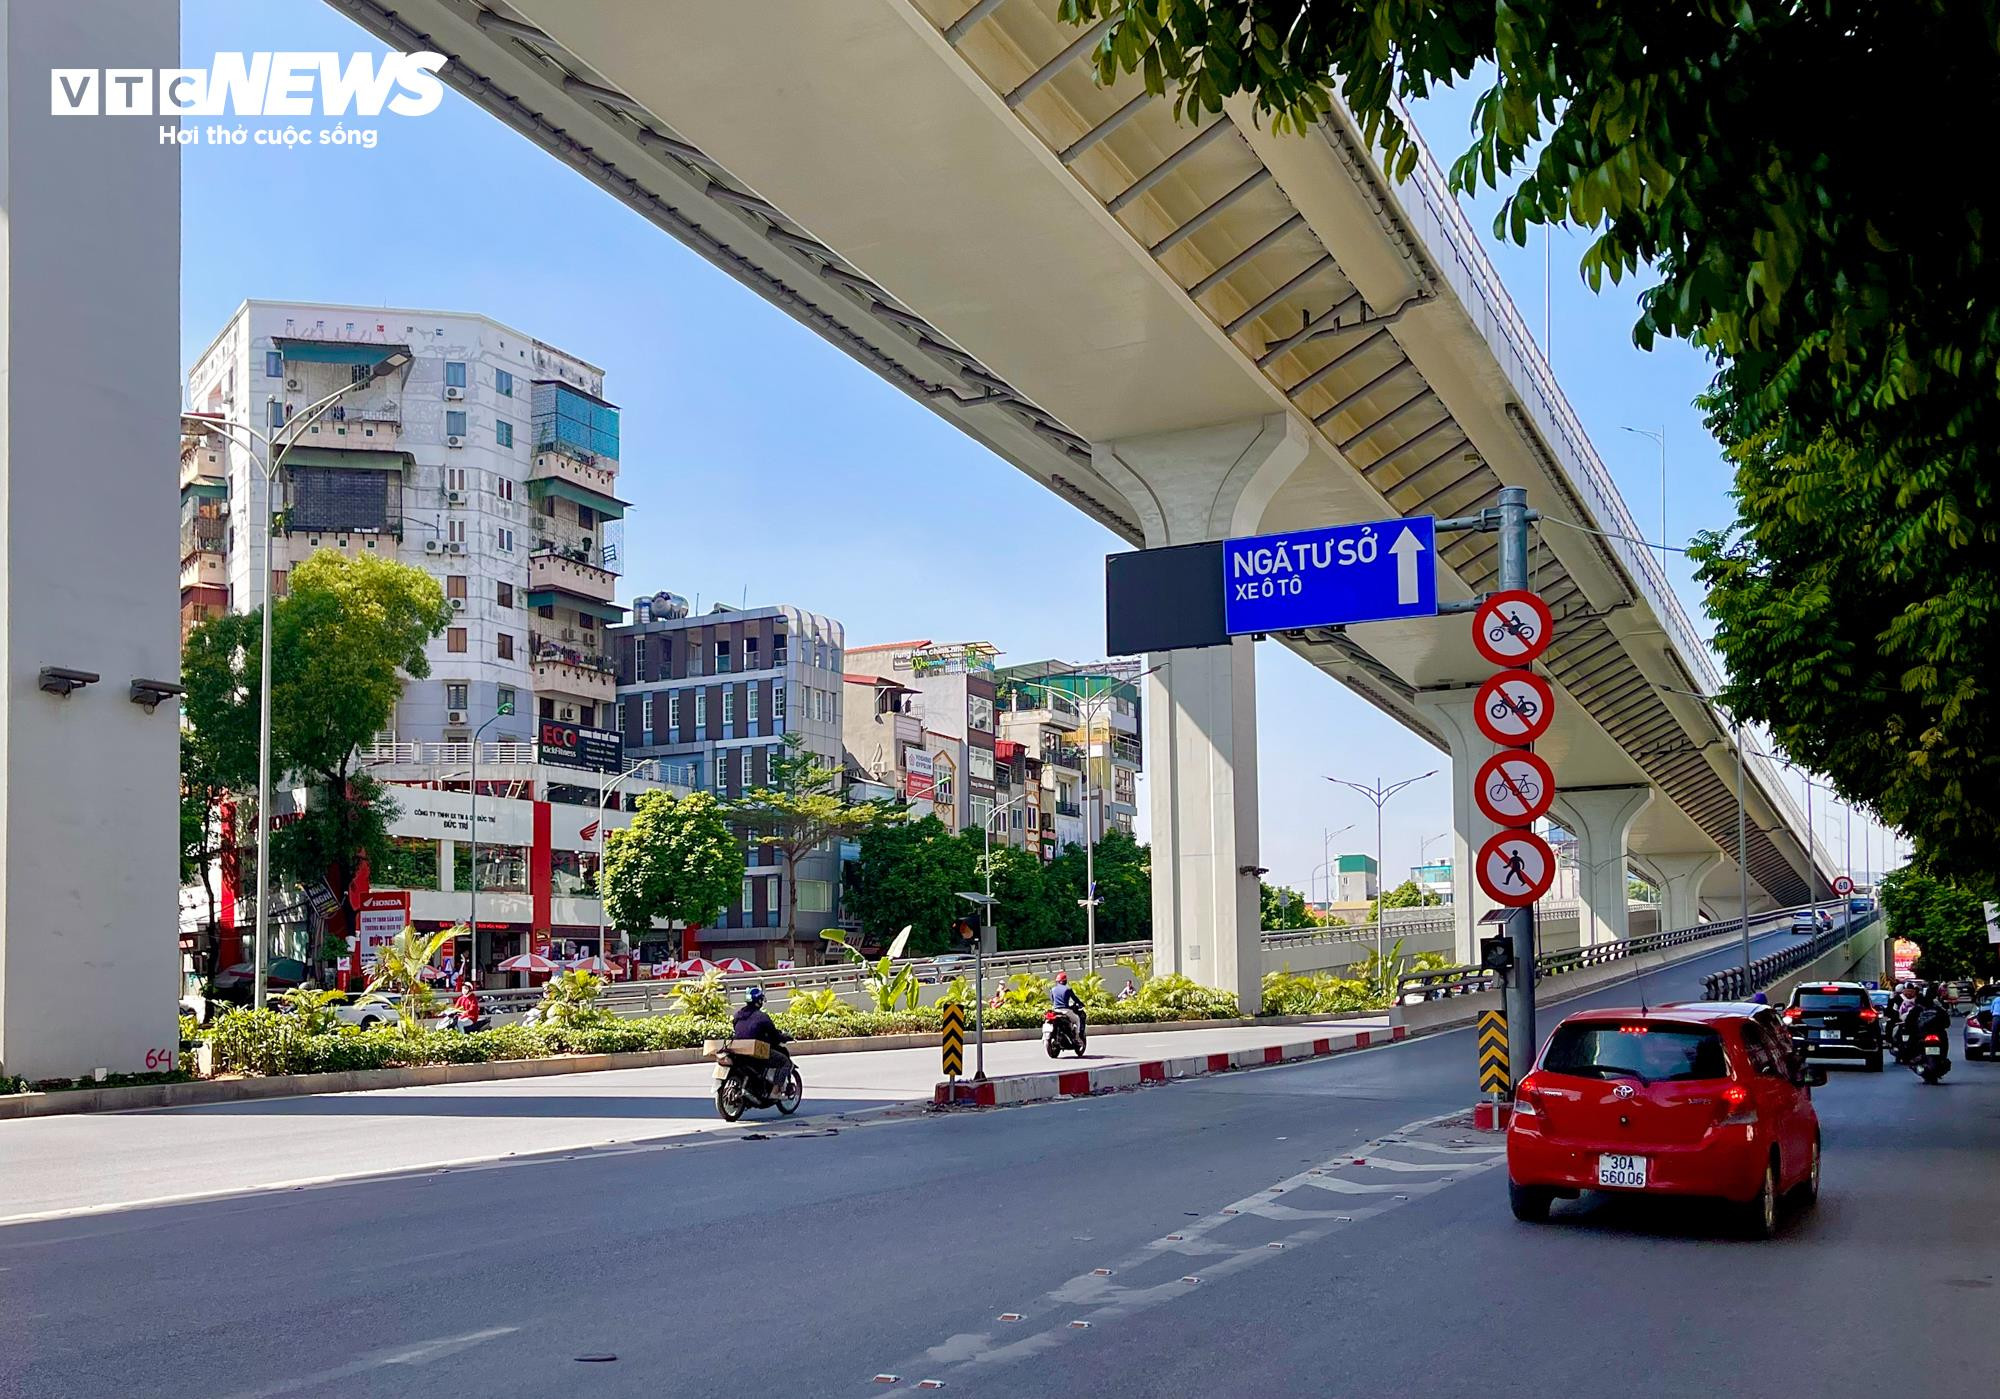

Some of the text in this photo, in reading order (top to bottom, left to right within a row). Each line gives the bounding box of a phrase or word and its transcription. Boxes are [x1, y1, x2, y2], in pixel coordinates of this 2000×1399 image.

[1233, 526, 1378, 578] NGÃ TƯ SỞ
[1235, 582, 1259, 601] XE
[1838, 881, 1848, 890] 60
[372, 899, 402, 907] HONDA
[145, 1048, 173, 1073] 64
[1611, 1156, 1634, 1171] 30A
[1601, 1170, 1644, 1186] 560.06
